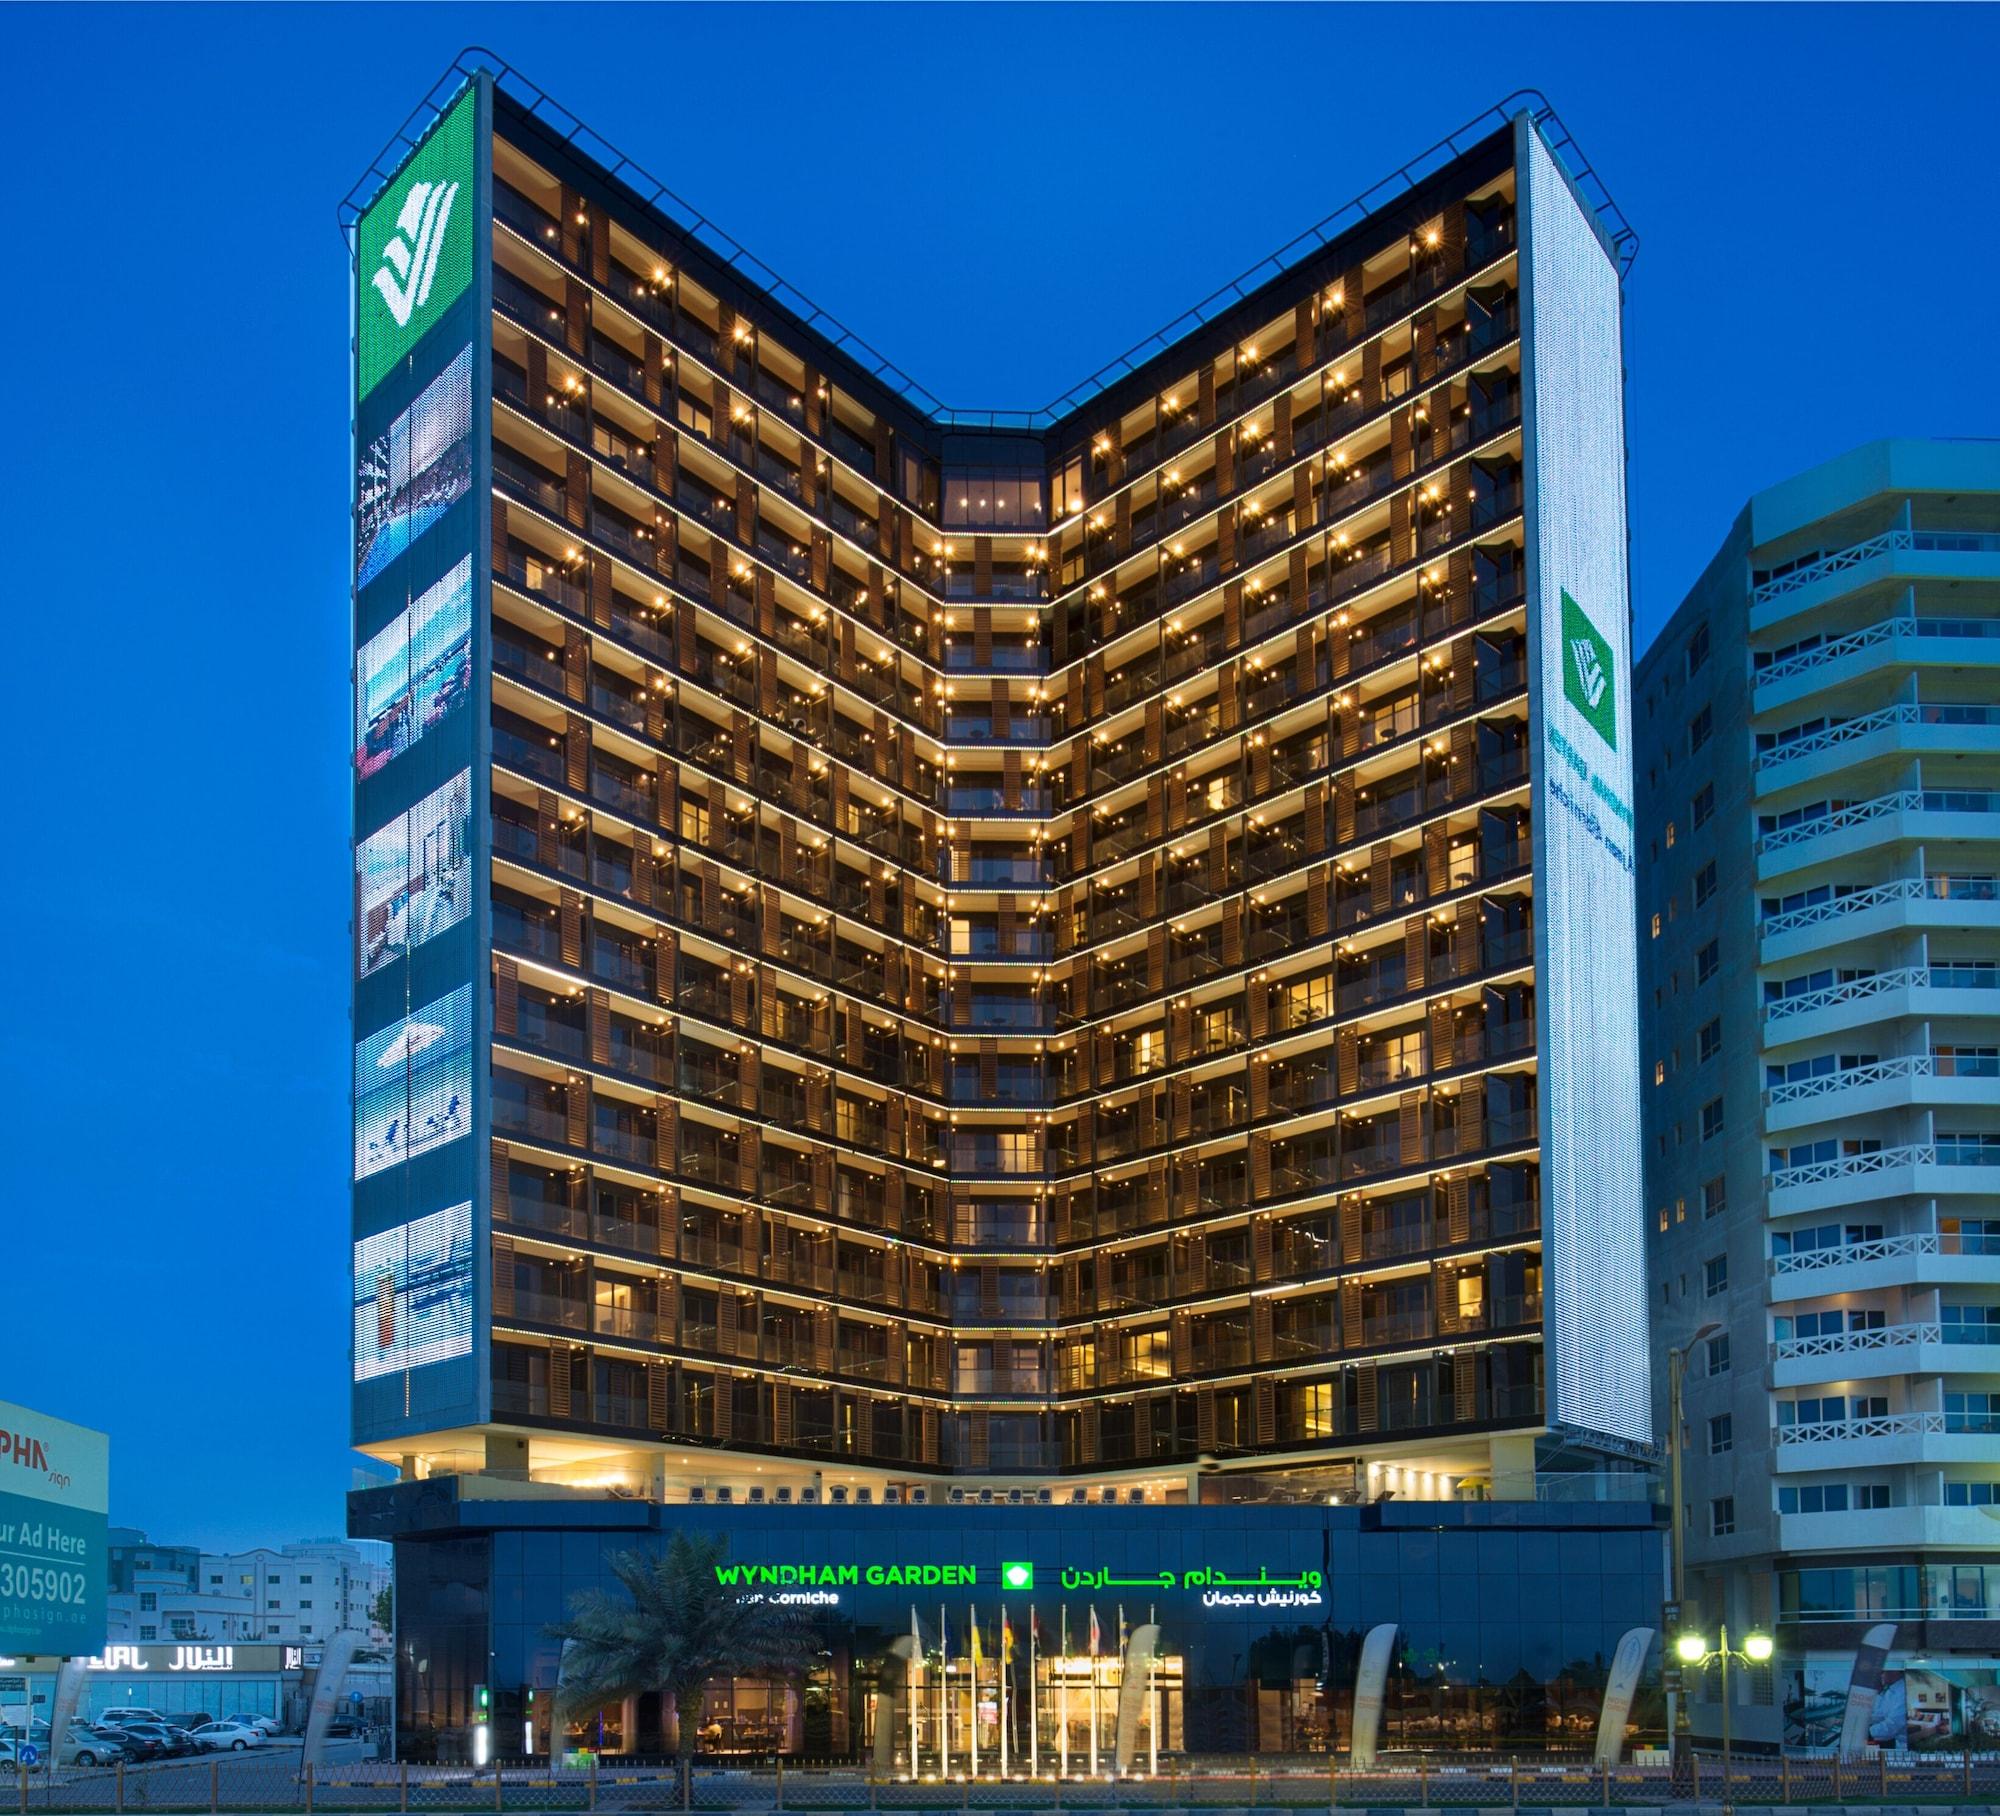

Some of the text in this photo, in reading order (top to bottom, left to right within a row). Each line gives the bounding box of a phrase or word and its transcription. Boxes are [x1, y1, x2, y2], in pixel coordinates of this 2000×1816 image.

[19, 1522, 42, 1549] Ad
[47, 1526, 87, 1556] Here
[0, 1562, 87, 1605] 305902
[714, 1565, 977, 1586] WYNDHAM GARDEN
[1202, 1589, 1323, 1608] كورنيش عجمان
